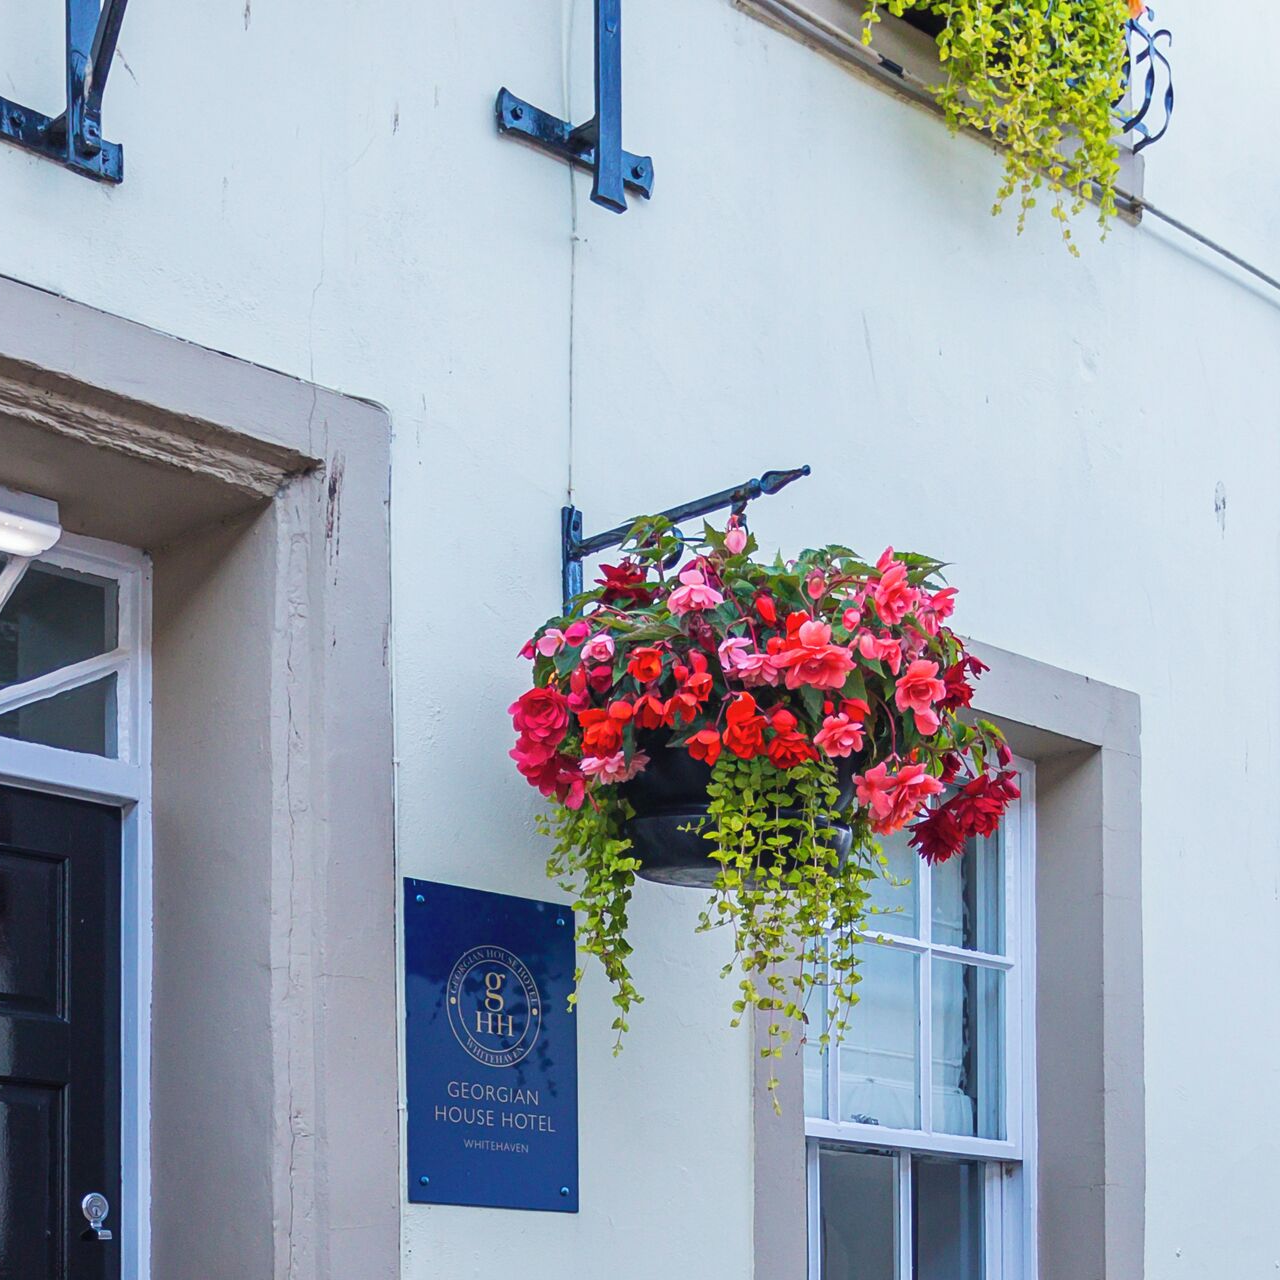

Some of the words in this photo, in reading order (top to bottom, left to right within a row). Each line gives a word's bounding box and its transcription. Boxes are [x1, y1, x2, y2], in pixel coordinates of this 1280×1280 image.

[450, 950, 484, 994] GEORGIAN
[485, 948, 518, 969] HOUSE
[517, 966, 539, 1003] HOTEL
[475, 1010, 515, 1037] HH
[466, 1037, 525, 1065] WHITEHAVEN
[447, 1081, 539, 1106] GEORGIAN
[435, 1104, 495, 1127] HOUSE
[501, 1112, 556, 1133] HOTEL
[463, 1139, 529, 1153] WHITEHAVEN
